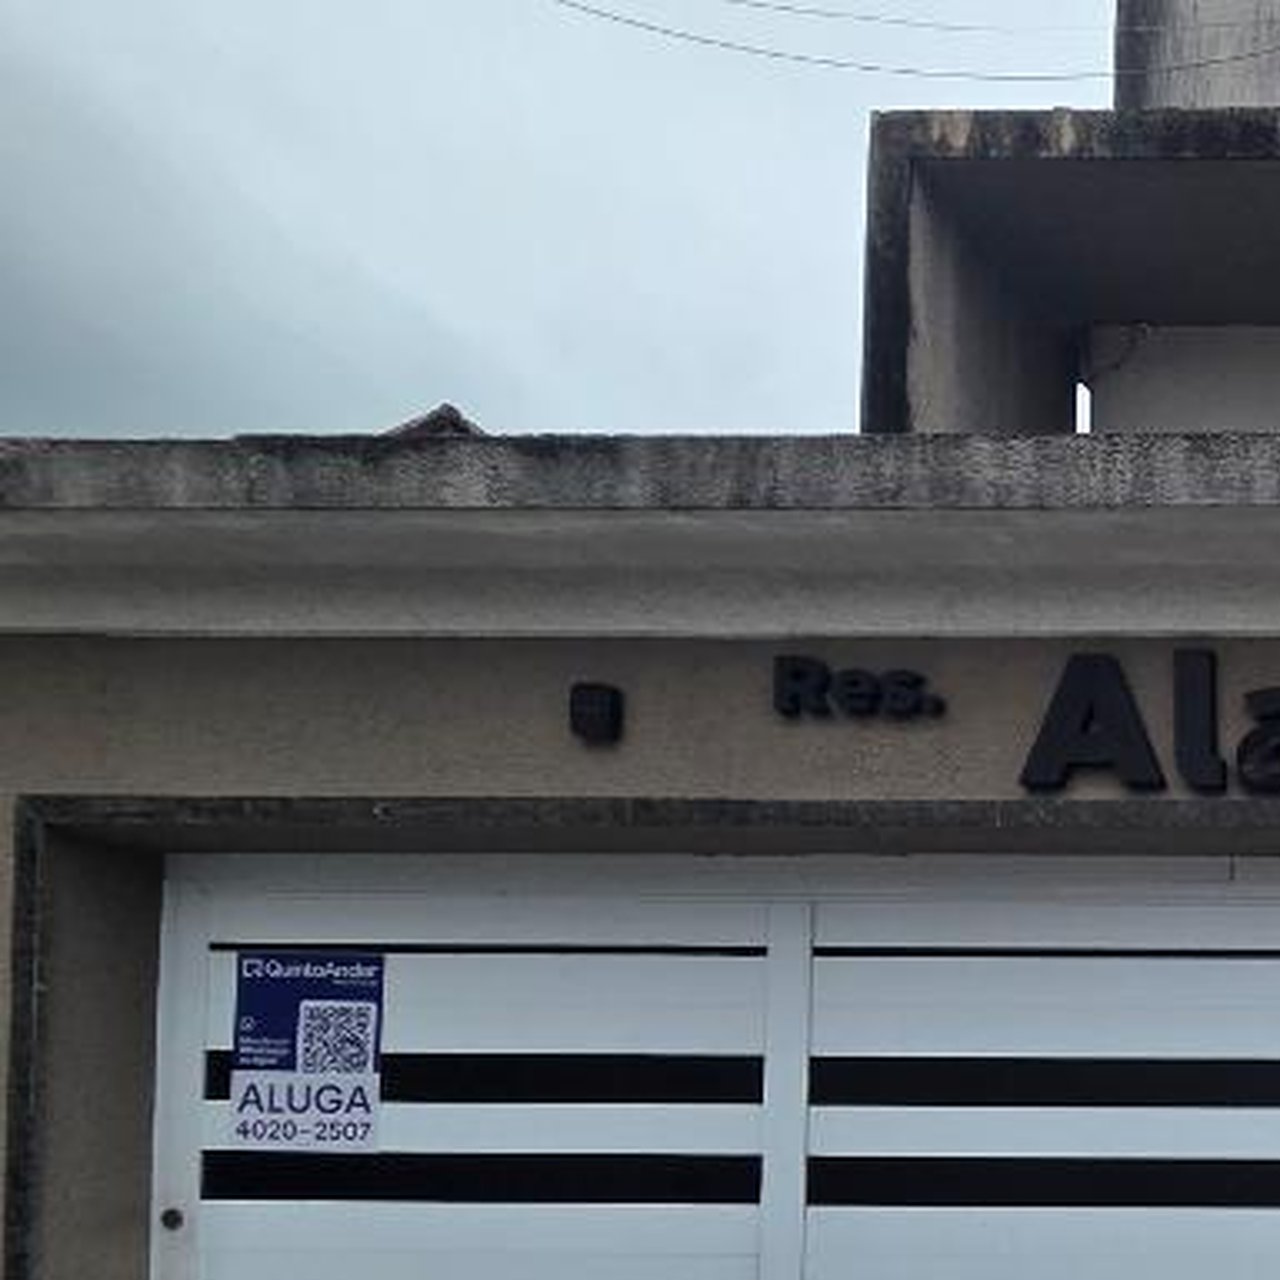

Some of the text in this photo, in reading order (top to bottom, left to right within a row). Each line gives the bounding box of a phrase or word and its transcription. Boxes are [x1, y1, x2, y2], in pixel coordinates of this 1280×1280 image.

[773, 654, 947, 721] Res.
[236, 1083, 372, 1115] ALUGA
[235, 1118, 372, 1141] 4020-2507
